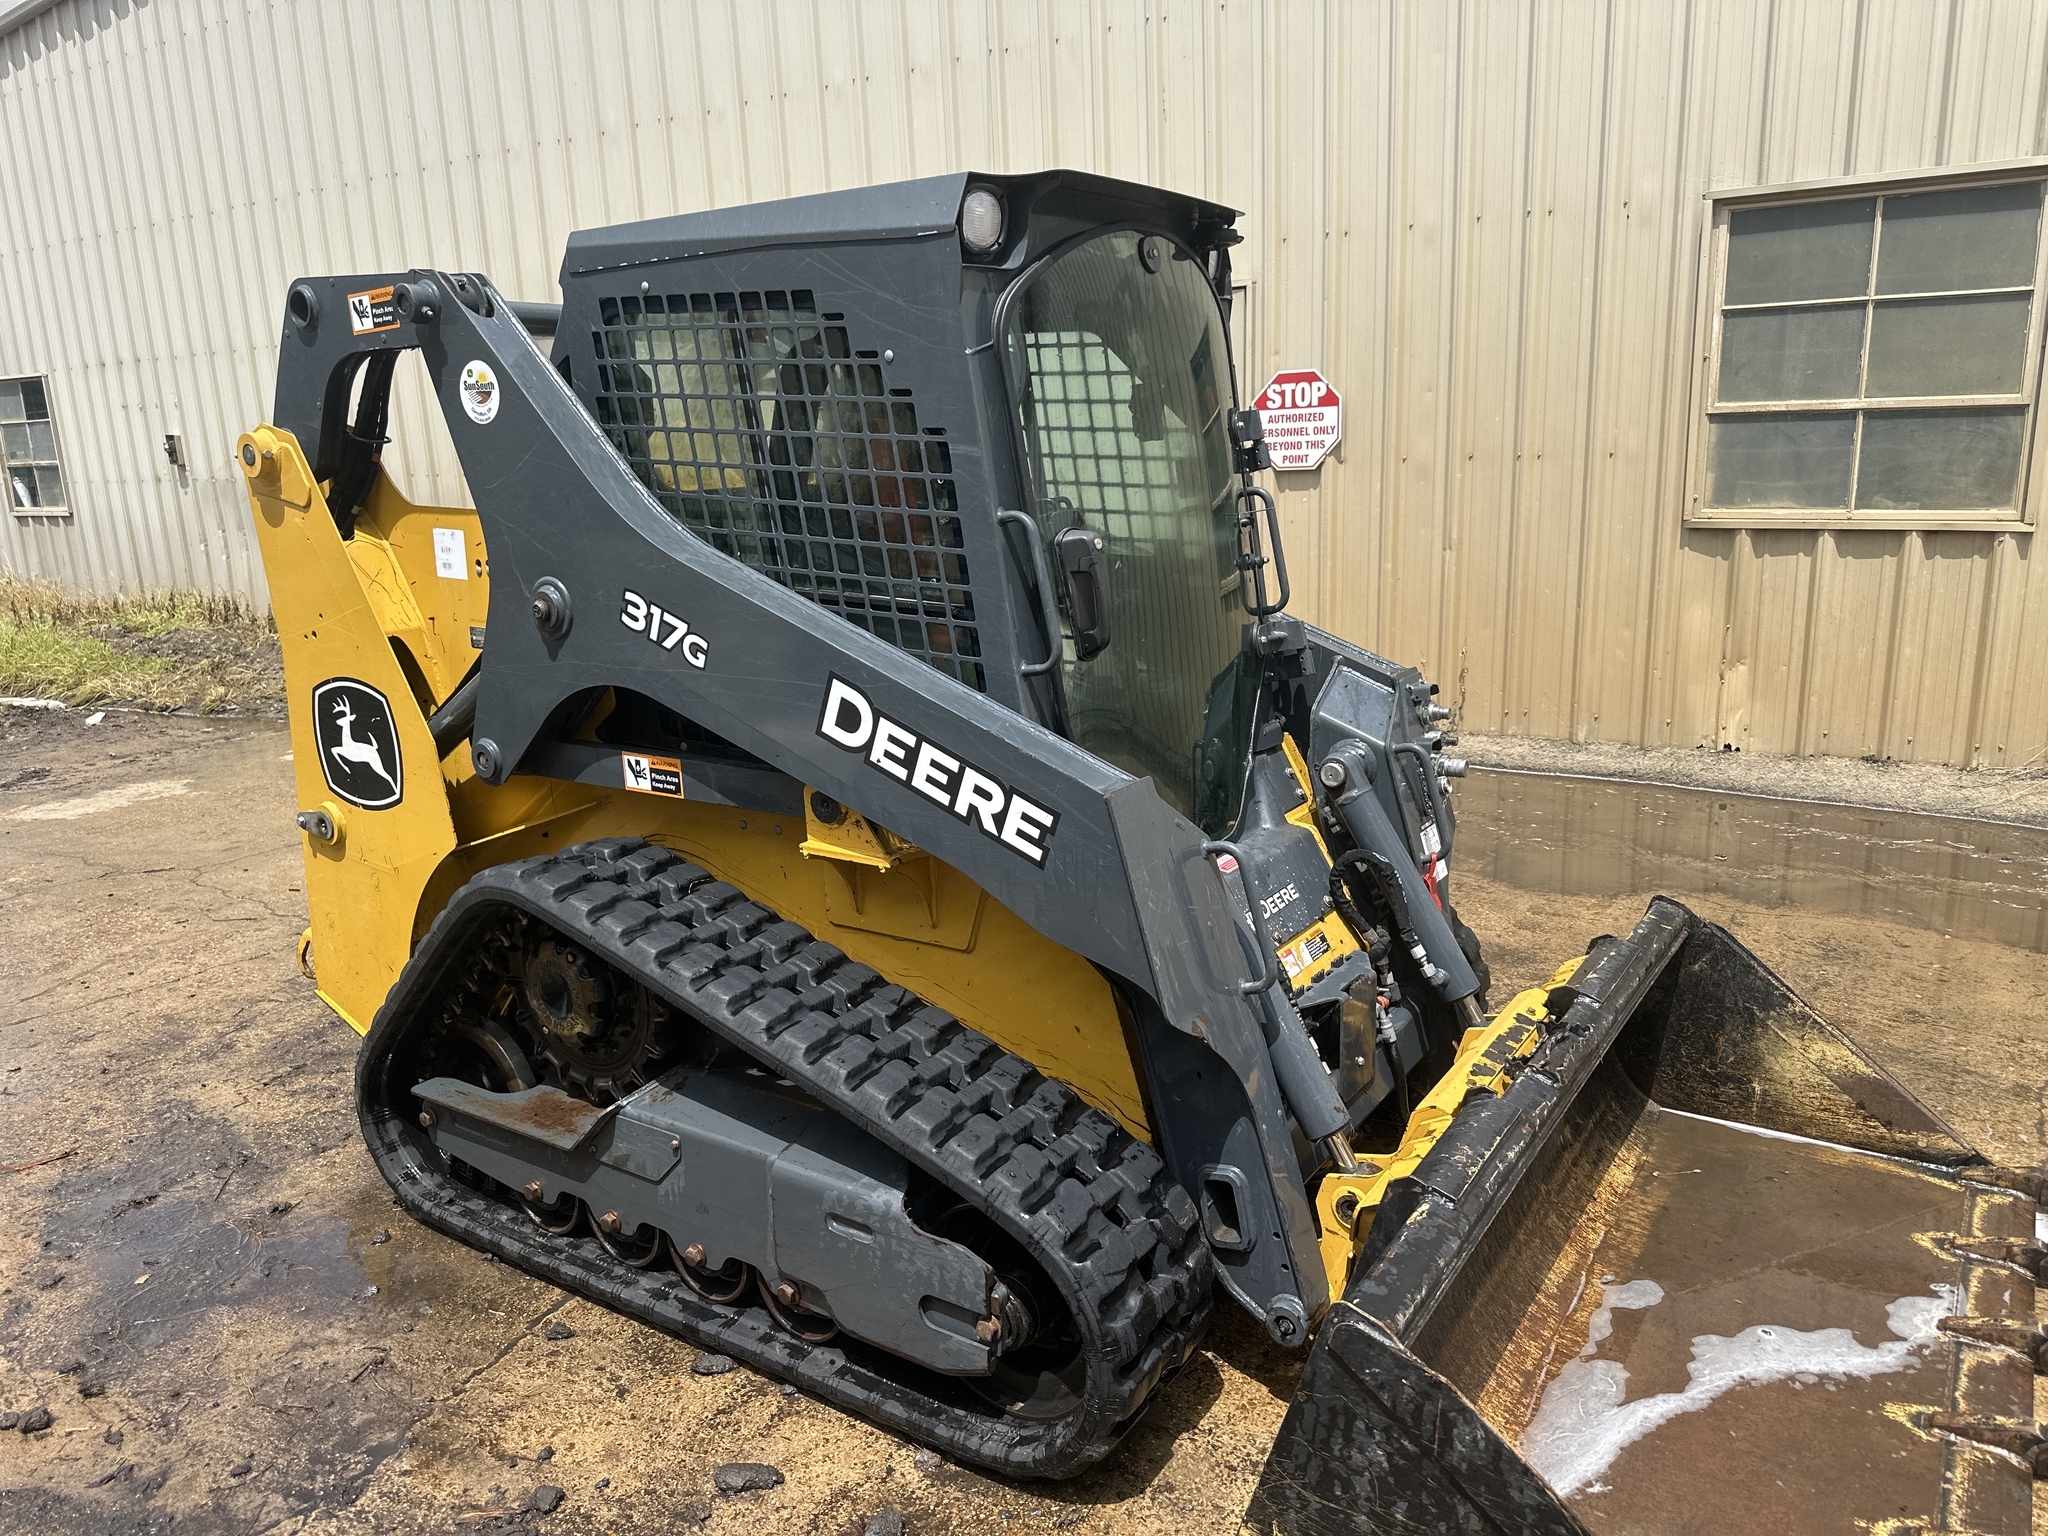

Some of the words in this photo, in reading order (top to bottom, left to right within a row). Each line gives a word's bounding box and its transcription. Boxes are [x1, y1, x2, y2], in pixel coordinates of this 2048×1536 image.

[372, 307, 384, 315] Pinch
[463, 380, 495, 391] SunSouth
[1266, 381, 1328, 409] STOP
[1268, 412, 1324, 424] AUTHORIZED
[1262, 427, 1310, 438] ERSONNEL
[1313, 425, 1336, 435] ONLY
[1267, 441, 1303, 451] BEYOND
[1305, 440, 1326, 450] THIS
[1282, 454, 1309, 464] POINT
[620, 590, 709, 669] 317G
[820, 677, 1054, 862] DEERE
[651, 772, 666, 781] Pinch
[667, 775, 679, 783] Area
[652, 781, 664, 789] Keep
[664, 782, 676, 791] Away
